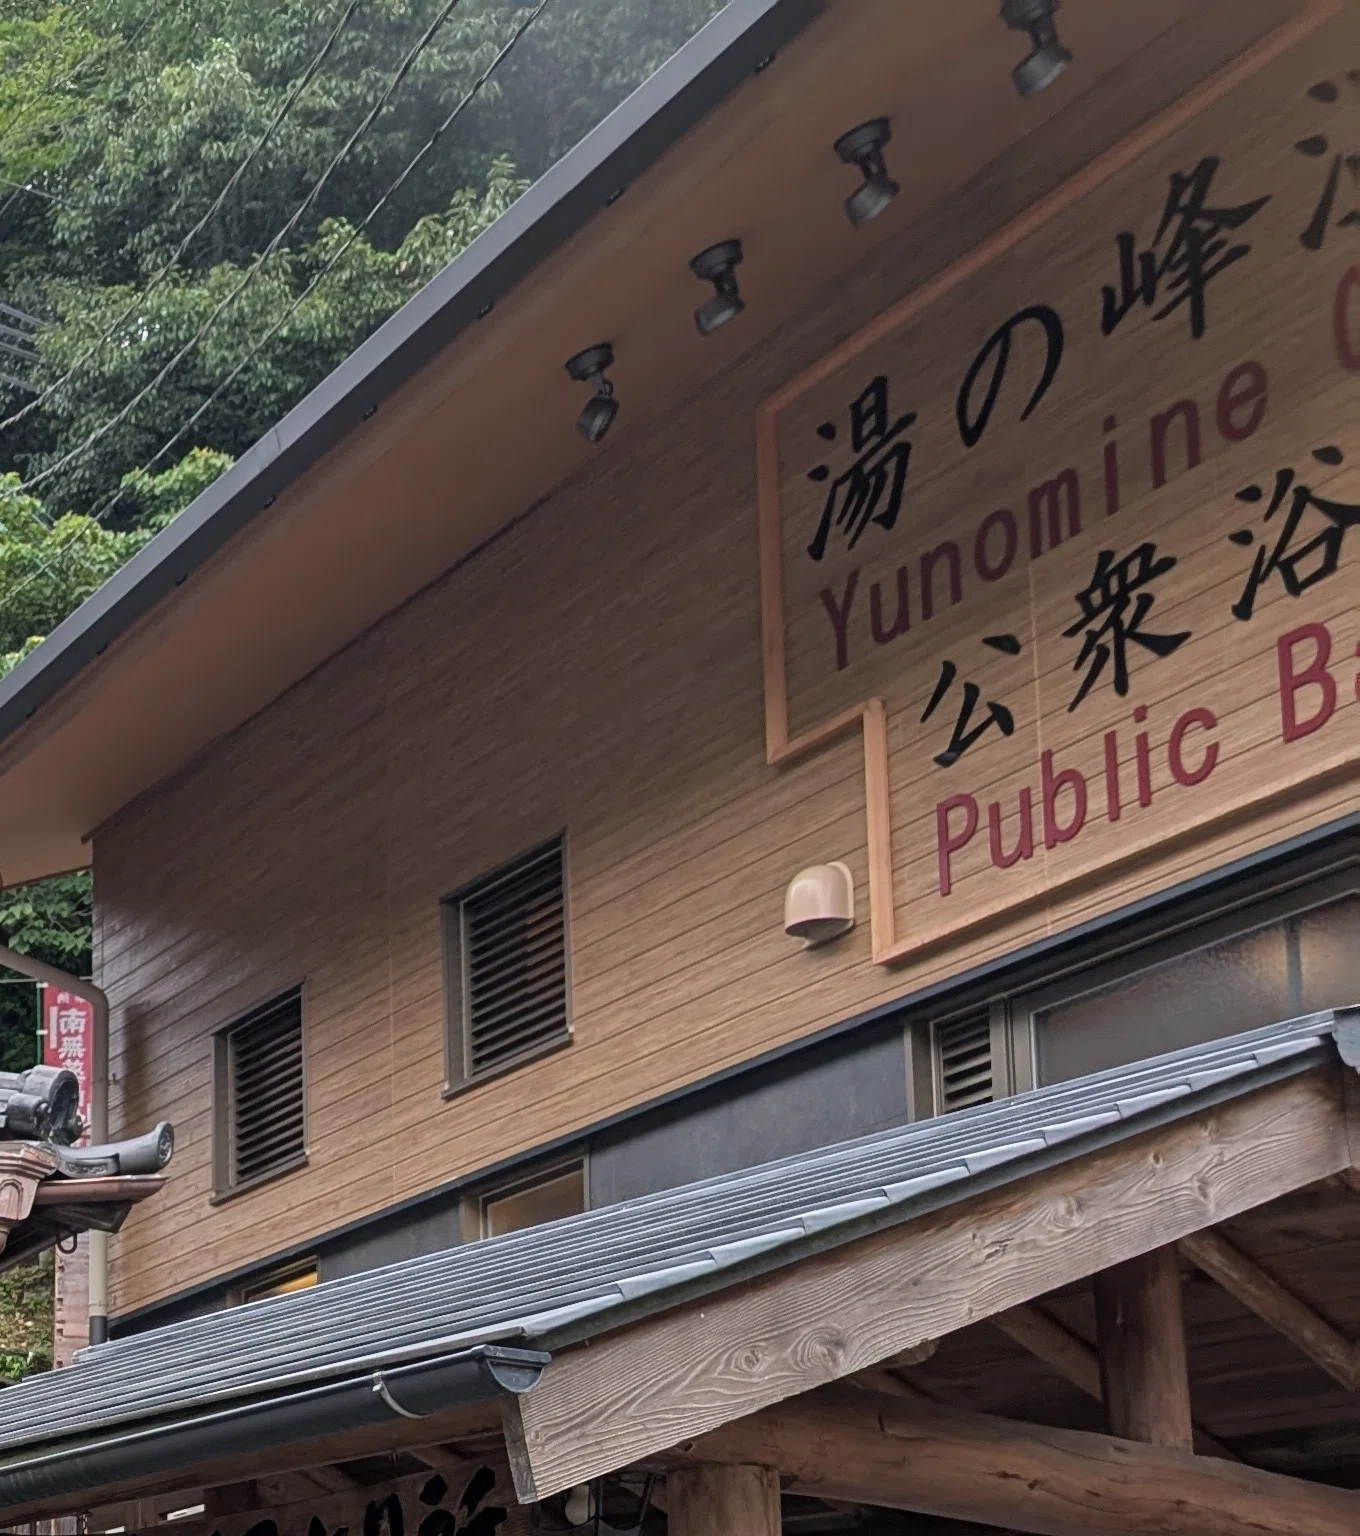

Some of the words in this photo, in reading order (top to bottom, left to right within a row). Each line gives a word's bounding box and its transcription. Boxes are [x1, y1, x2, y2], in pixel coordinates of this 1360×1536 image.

[819, 360, 1270, 671] Yunomine
[934, 702, 1220, 897] Public
[1278, 620, 1360, 745] B
